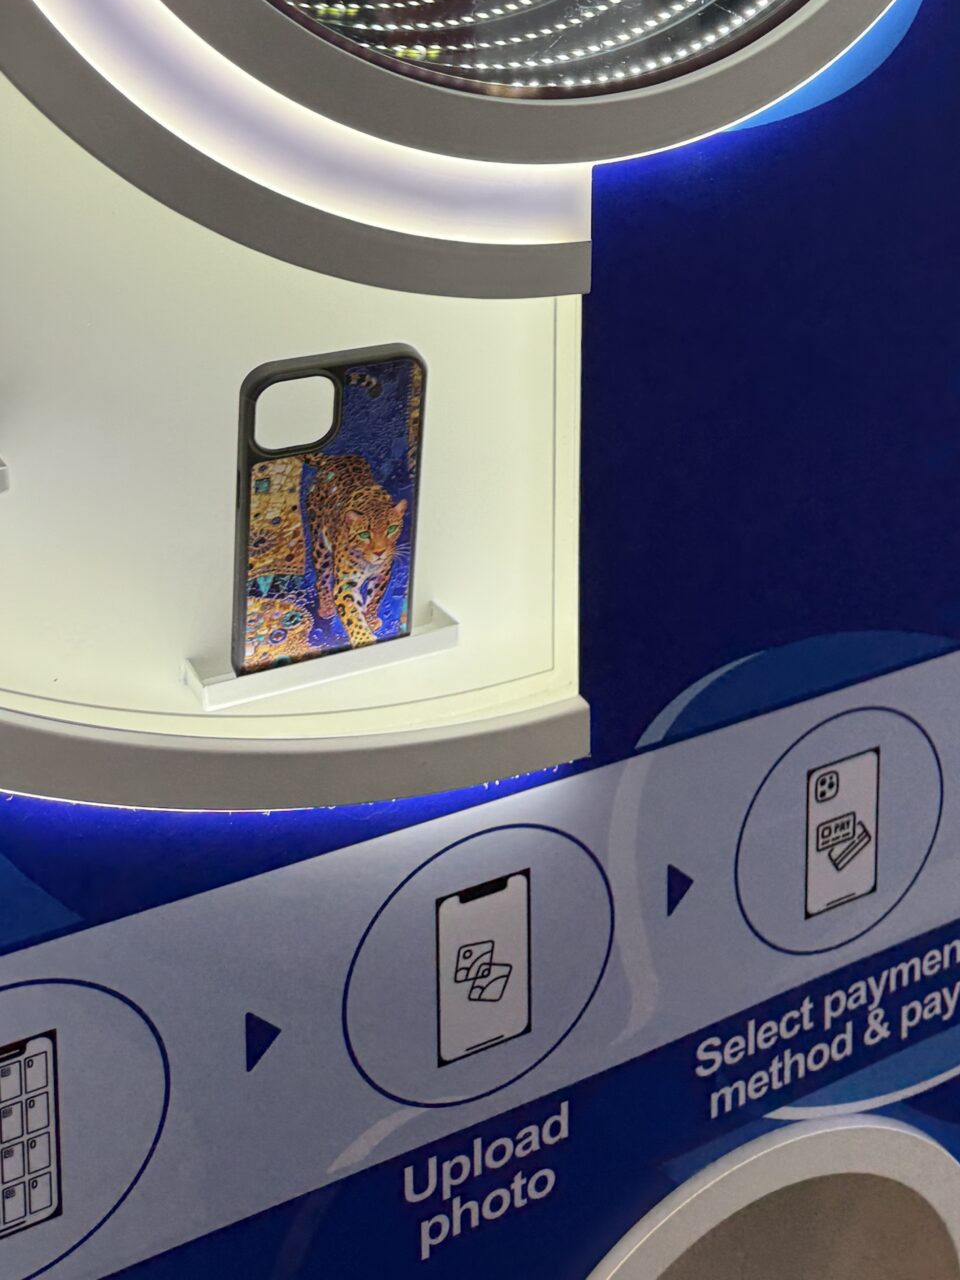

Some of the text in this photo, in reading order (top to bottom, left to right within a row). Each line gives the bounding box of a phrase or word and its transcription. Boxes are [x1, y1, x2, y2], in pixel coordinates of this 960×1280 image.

[833, 820, 851, 835] PAY
[695, 995, 815, 1078] Select
[710, 1020, 854, 1120] method
[862, 1006, 891, 1046] &
[403, 1100, 570, 1204] Upload
[420, 1167, 557, 1261] photo
